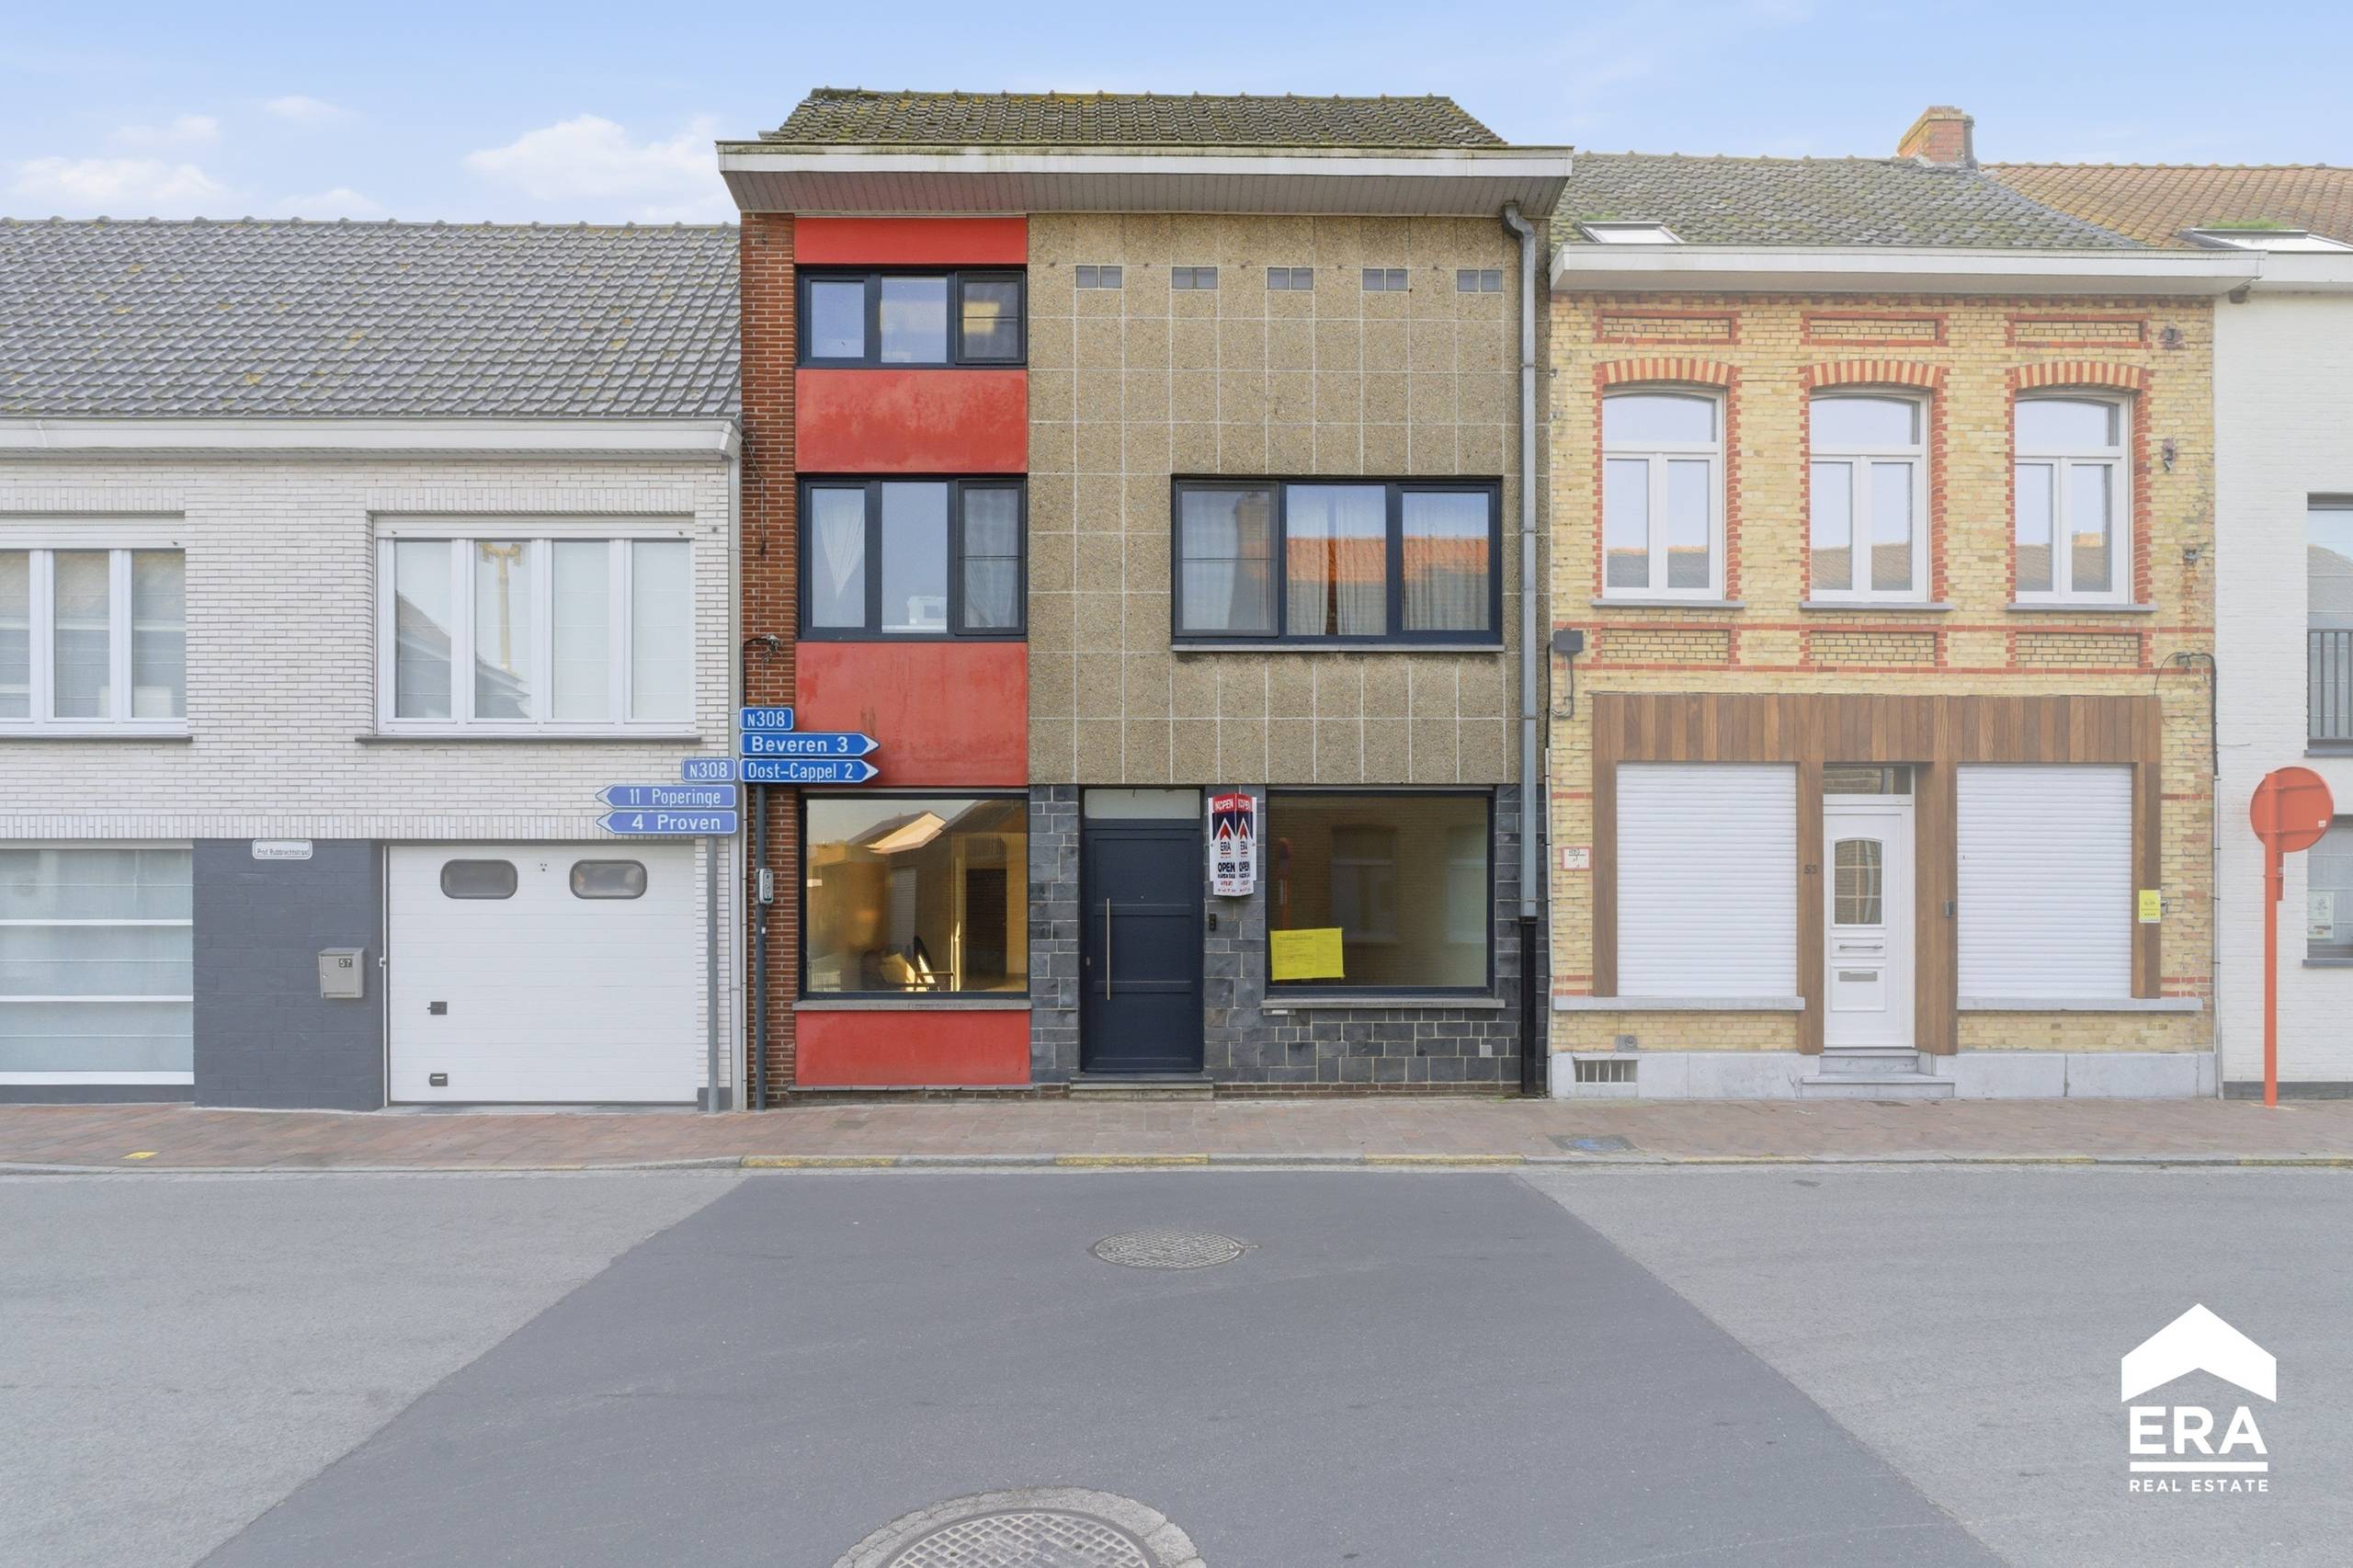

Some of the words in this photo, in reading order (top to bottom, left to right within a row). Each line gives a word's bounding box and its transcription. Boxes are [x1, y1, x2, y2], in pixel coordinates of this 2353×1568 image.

[747, 710, 785, 727] N308
[751, 736, 827, 753] Beveren
[836, 736, 848, 753] 3
[689, 762, 728, 778] N308
[747, 764, 836, 782] Oost-Cappel
[844, 764, 853, 779] 2
[630, 789, 641, 805] 11
[652, 789, 722, 808] Poperinge
[631, 814, 643, 830] 4
[657, 814, 721, 830] Proven
[1218, 862, 1235, 872] OPEN
